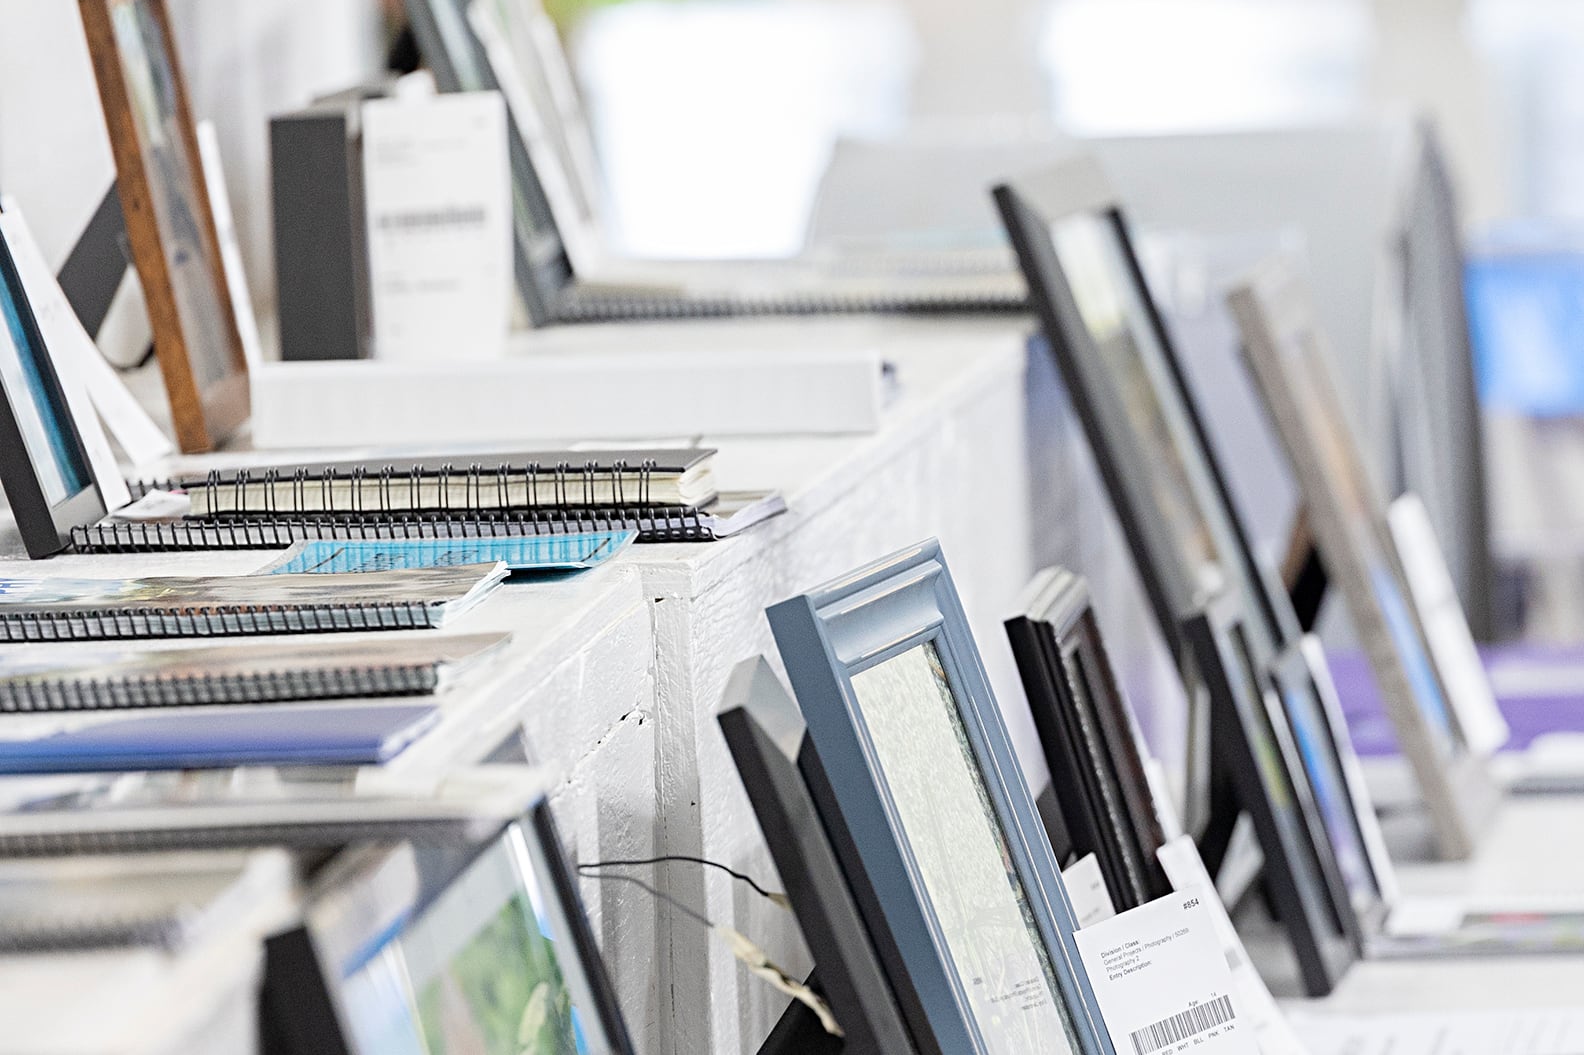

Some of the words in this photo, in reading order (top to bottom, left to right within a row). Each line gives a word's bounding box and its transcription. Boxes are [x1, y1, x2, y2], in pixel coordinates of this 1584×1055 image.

[1183, 898, 1199, 909] #854
[1144, 935, 1172, 949] Photography
[1101, 947, 1121, 958] Division
[1106, 959, 1135, 972] Photography
[1109, 971, 1123, 981] Entry
